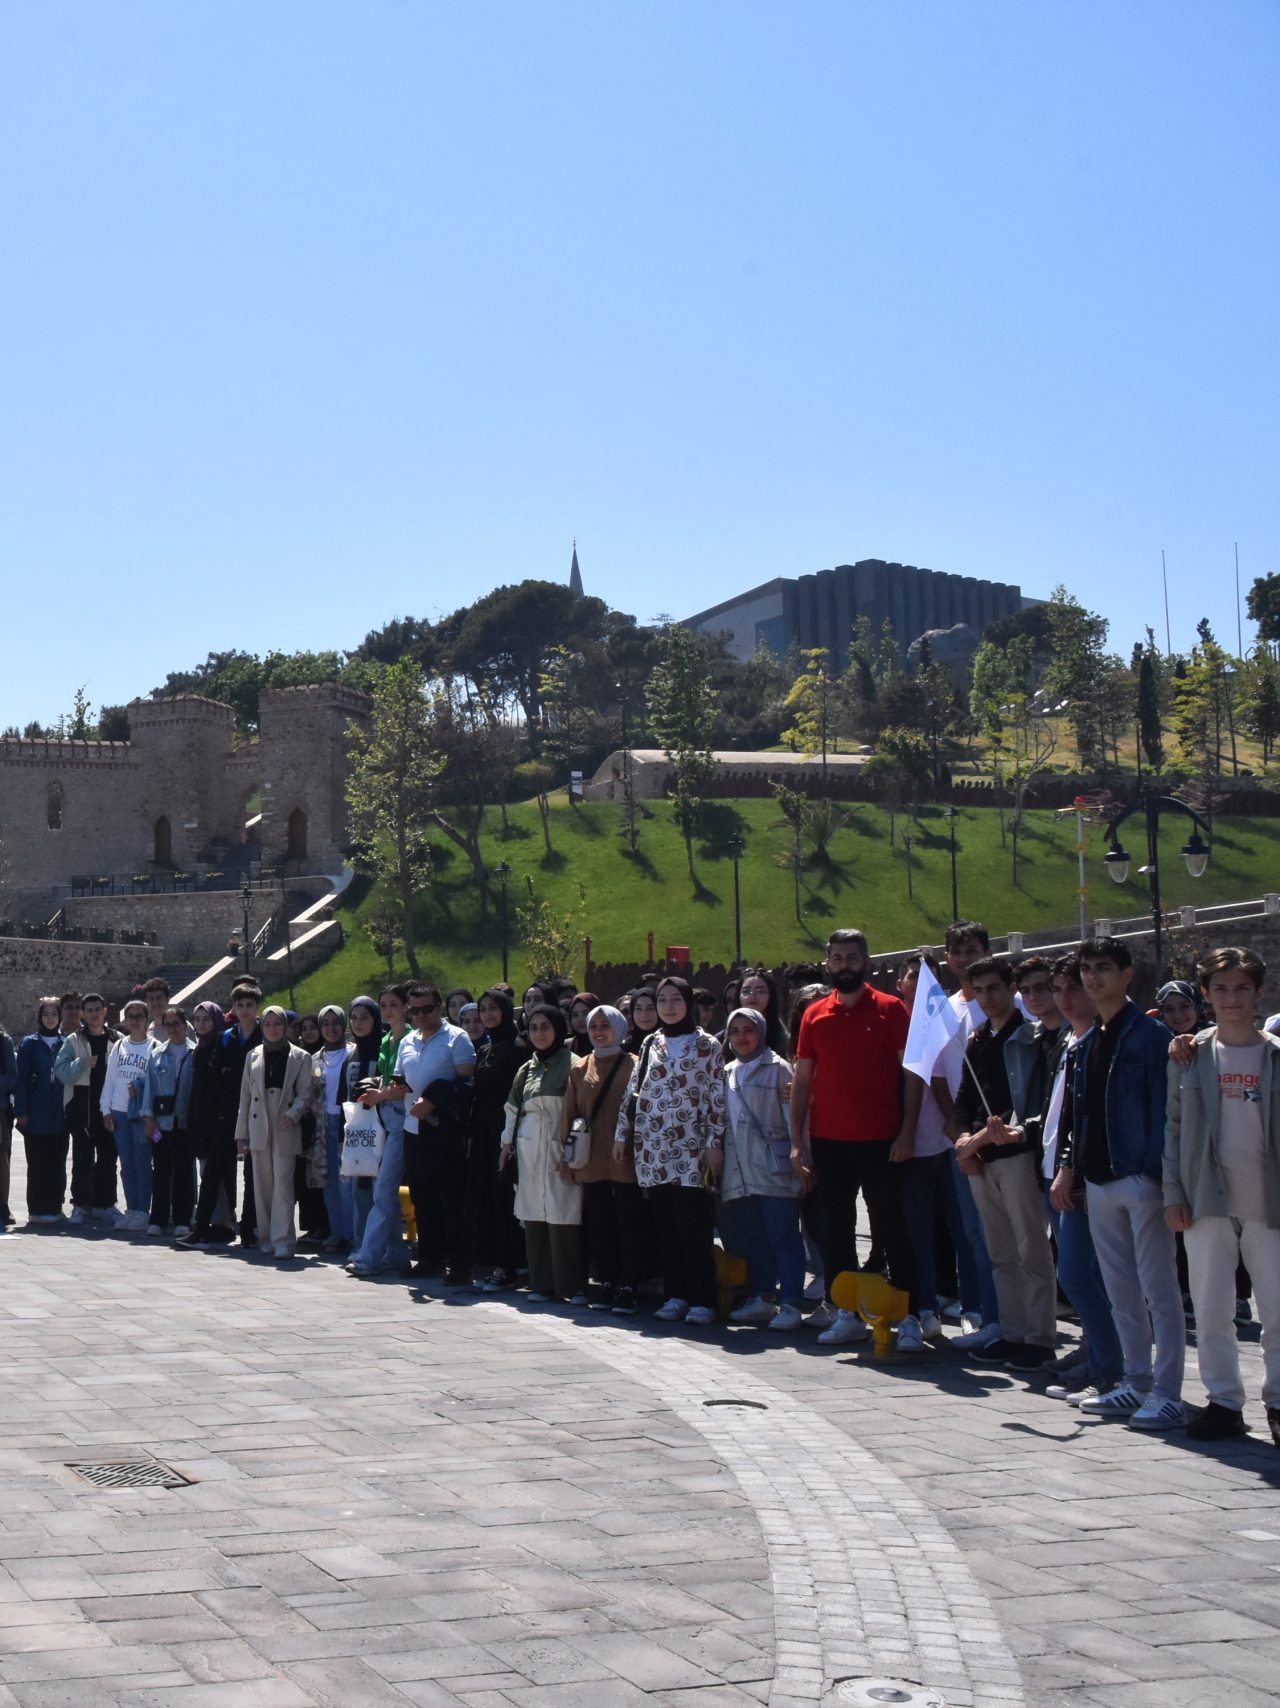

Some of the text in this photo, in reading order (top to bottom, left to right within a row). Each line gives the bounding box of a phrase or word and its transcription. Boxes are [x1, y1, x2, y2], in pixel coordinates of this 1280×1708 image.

[346, 1130, 376, 1139] BARRELS
[345, 1138, 376, 1147] AND OIL
